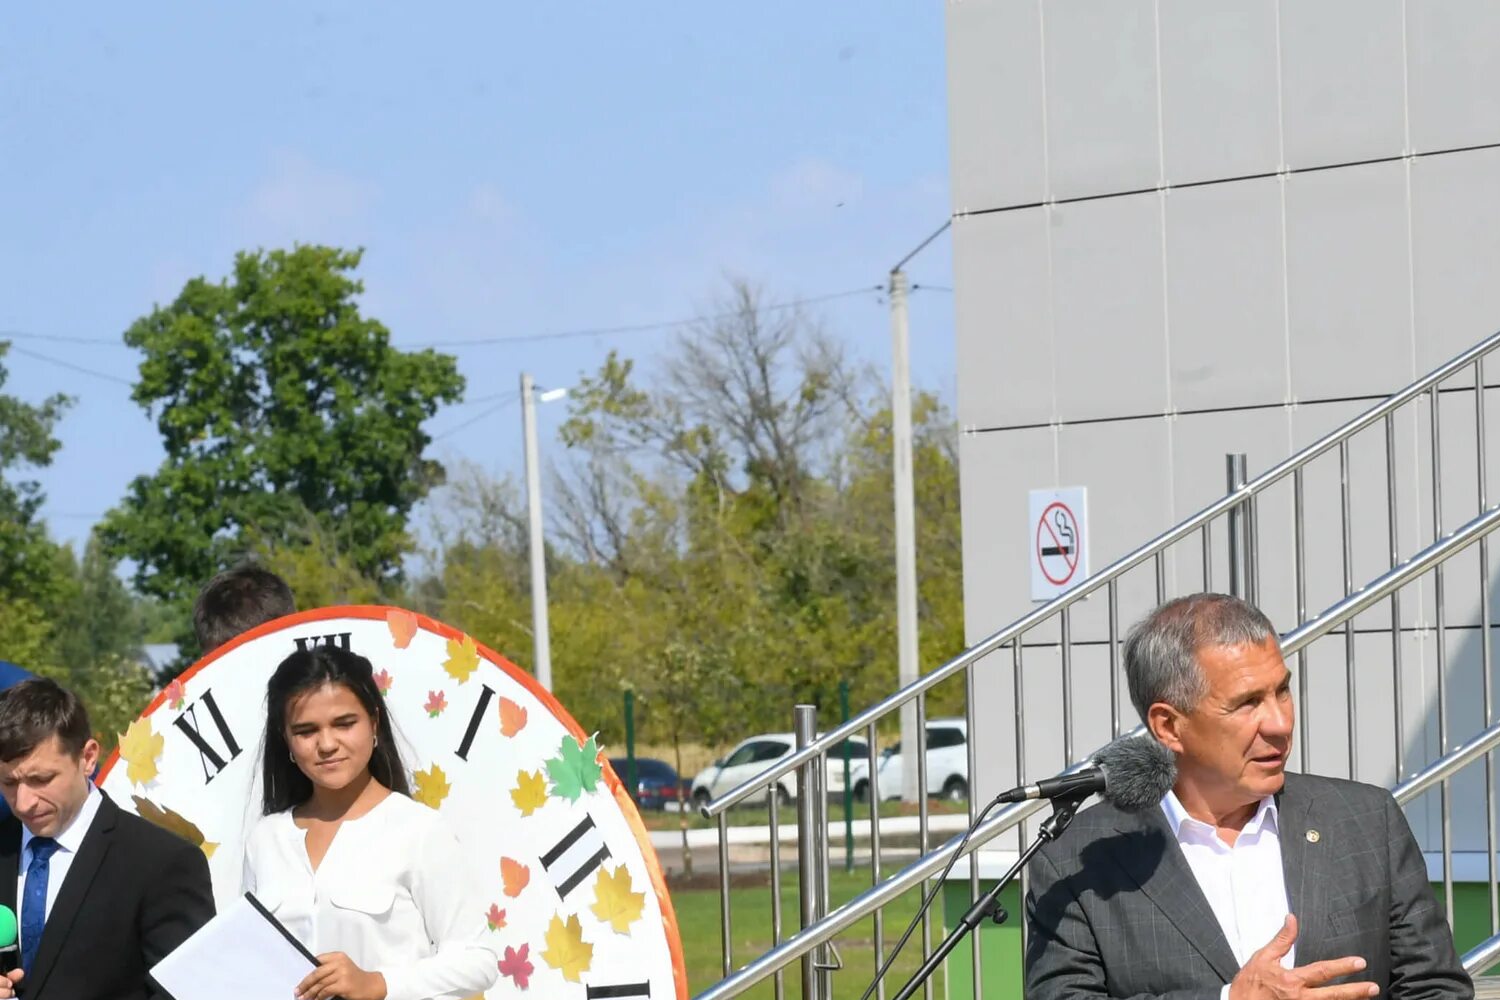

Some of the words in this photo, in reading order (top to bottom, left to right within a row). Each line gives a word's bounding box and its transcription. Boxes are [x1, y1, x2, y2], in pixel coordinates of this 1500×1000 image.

[172, 687, 243, 785] XI
[454, 684, 496, 762] I
[538, 812, 613, 902] II
